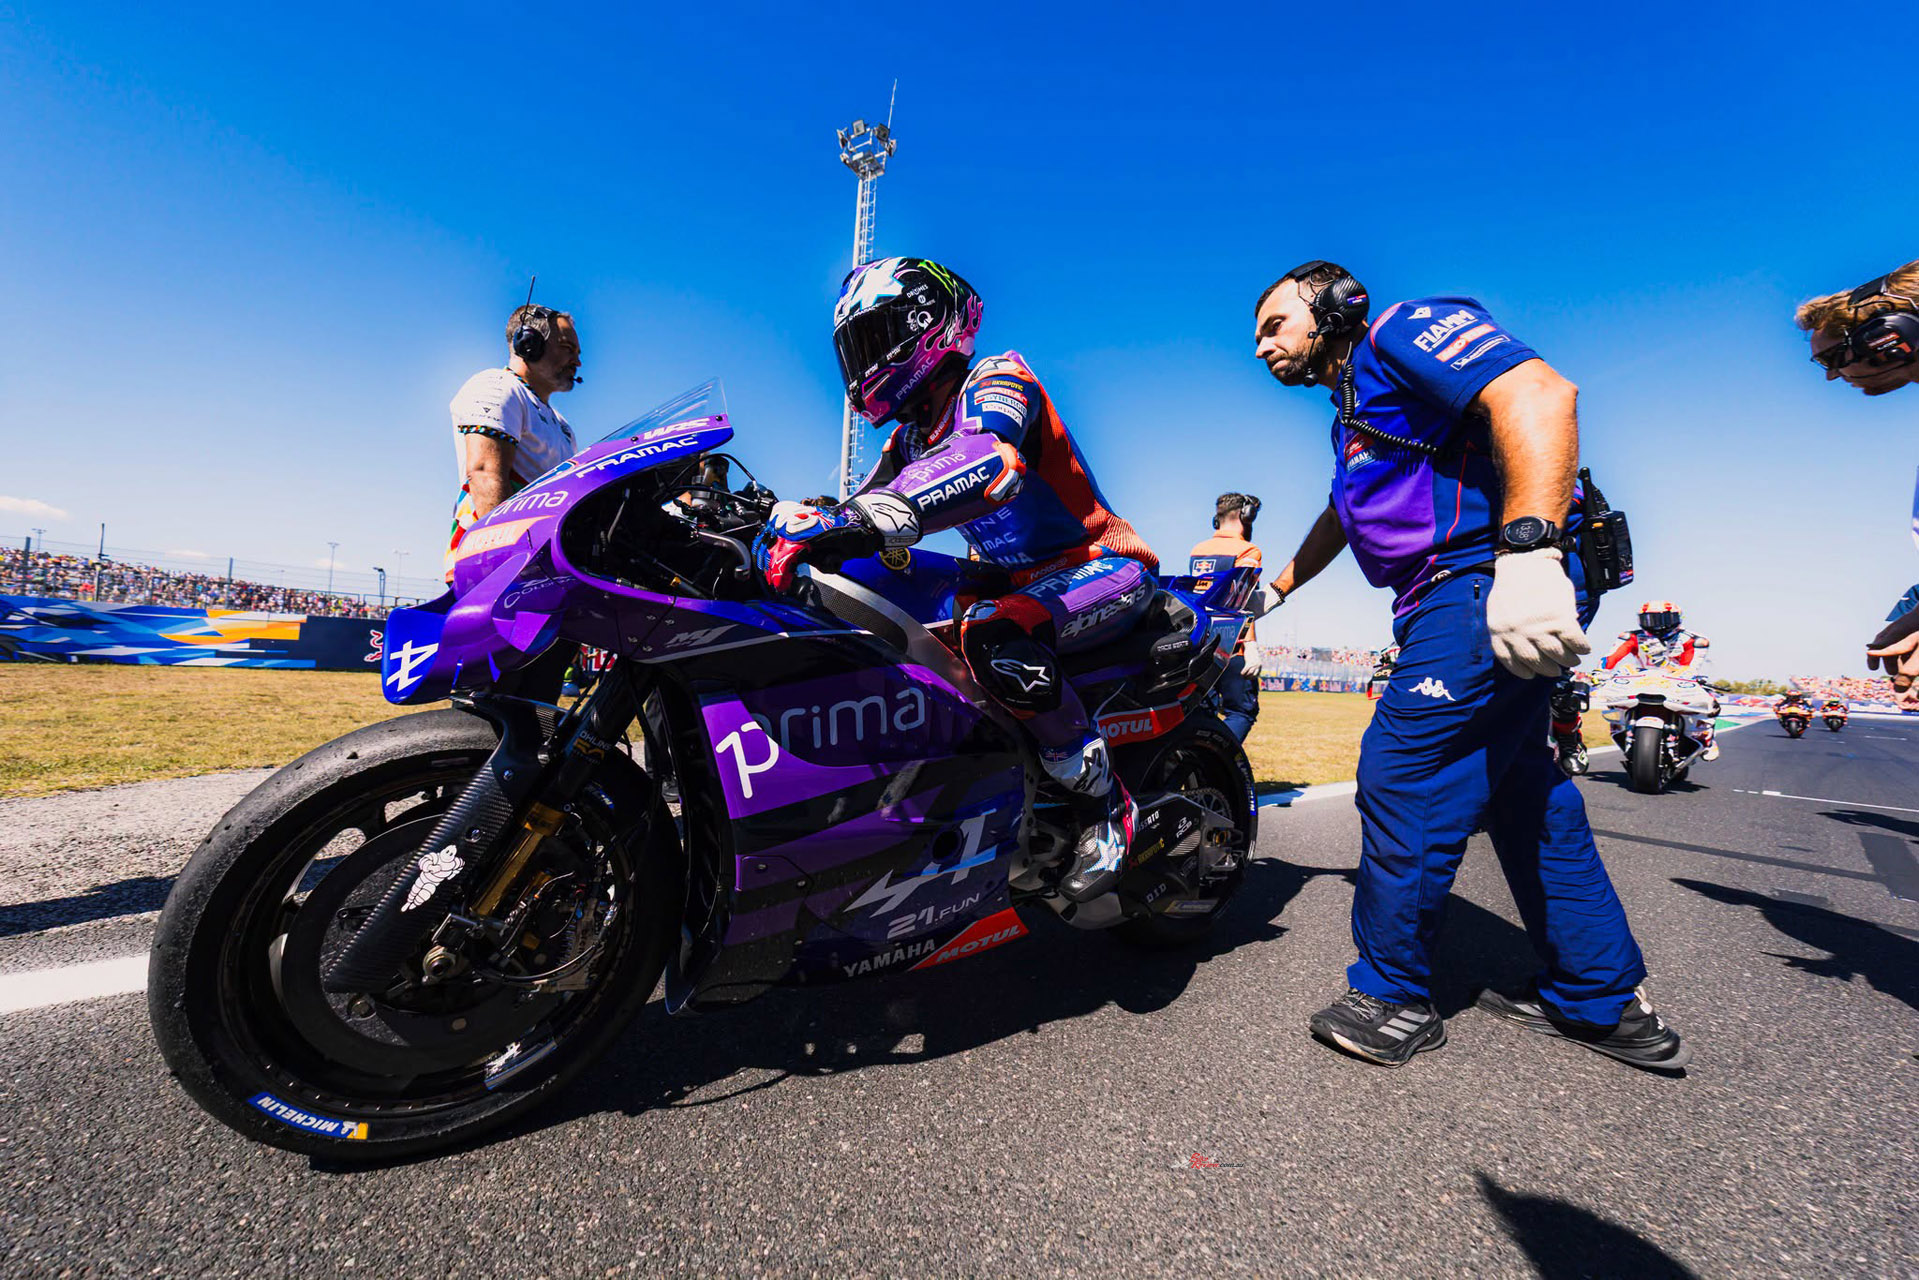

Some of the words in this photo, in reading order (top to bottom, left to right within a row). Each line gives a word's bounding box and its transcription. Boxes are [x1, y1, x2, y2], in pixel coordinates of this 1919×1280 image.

[1413, 310, 1476, 351] FIAMM
[896, 357, 934, 399] PRAMAC
[575, 436, 699, 479] PRAMAC
[911, 451, 966, 484] prima
[484, 490, 569, 526] prima
[917, 466, 990, 512] PRAMAC
[1061, 584, 1146, 638] alpinestars
[715, 686, 926, 799] prima
[887, 893, 980, 940] 21.FUN
[843, 938, 936, 978] YAMAHA
[936, 924, 1021, 962] MOTUL
[257, 1096, 340, 1133] MICHELIN
